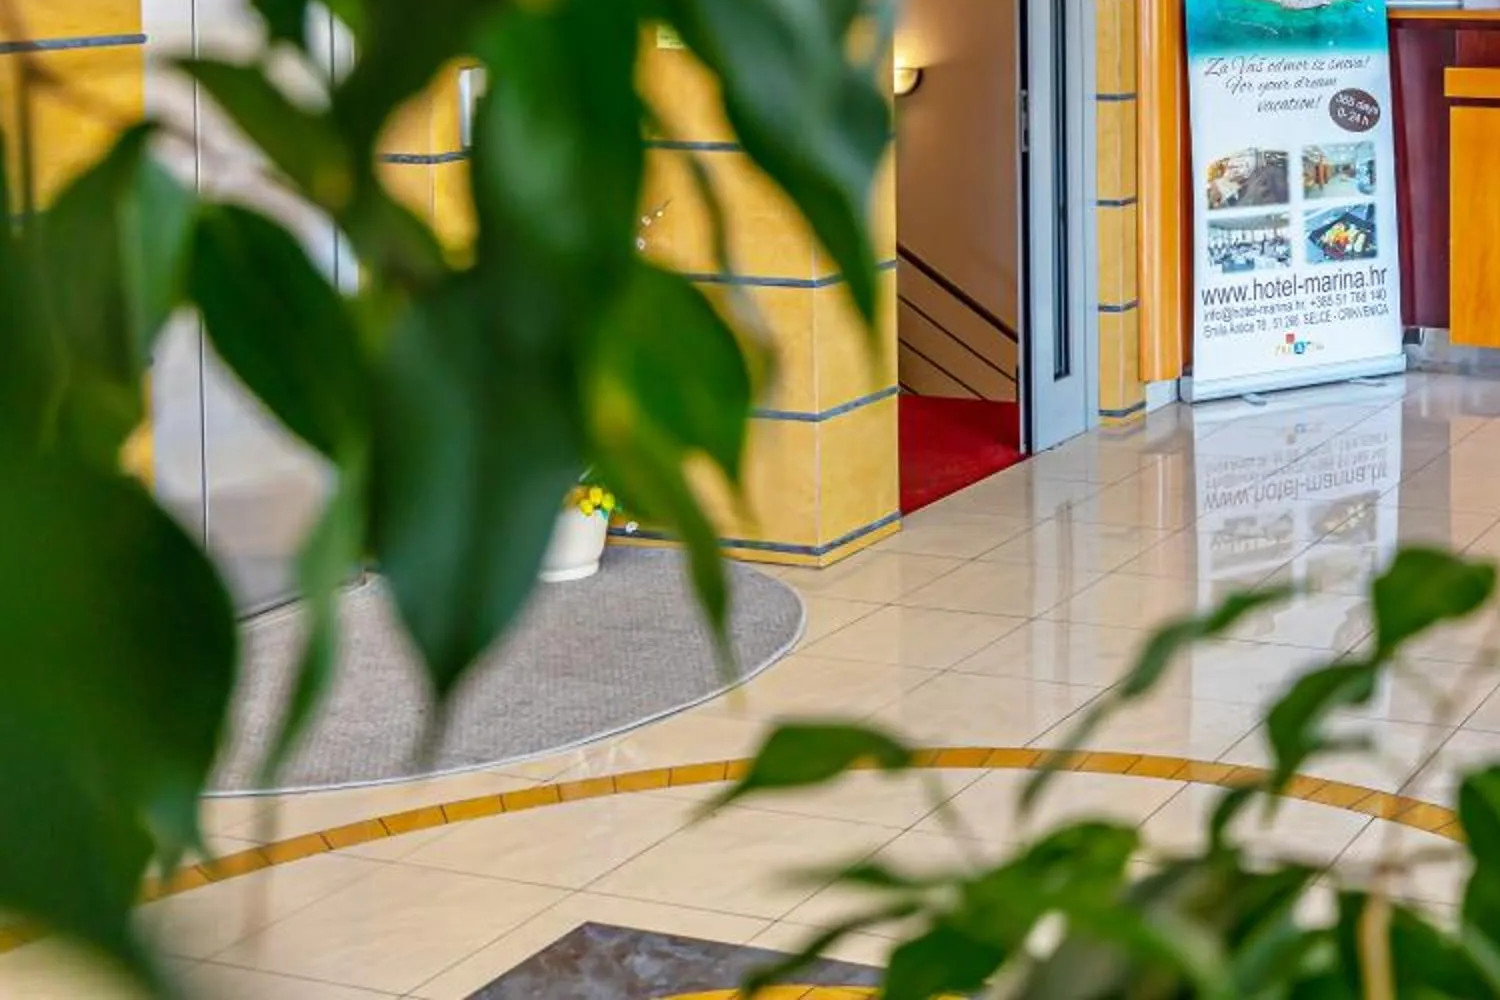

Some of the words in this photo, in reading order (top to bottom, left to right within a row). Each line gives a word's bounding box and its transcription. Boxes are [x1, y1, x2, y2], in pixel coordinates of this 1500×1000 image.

[1203, 57, 1229, 77] Za
[1257, 79, 1290, 98] your
[1294, 75, 1337, 89] dream
[1257, 94, 1323, 113] vacation!
[1201, 265, 1387, 306] www.hotel-marina.hr
